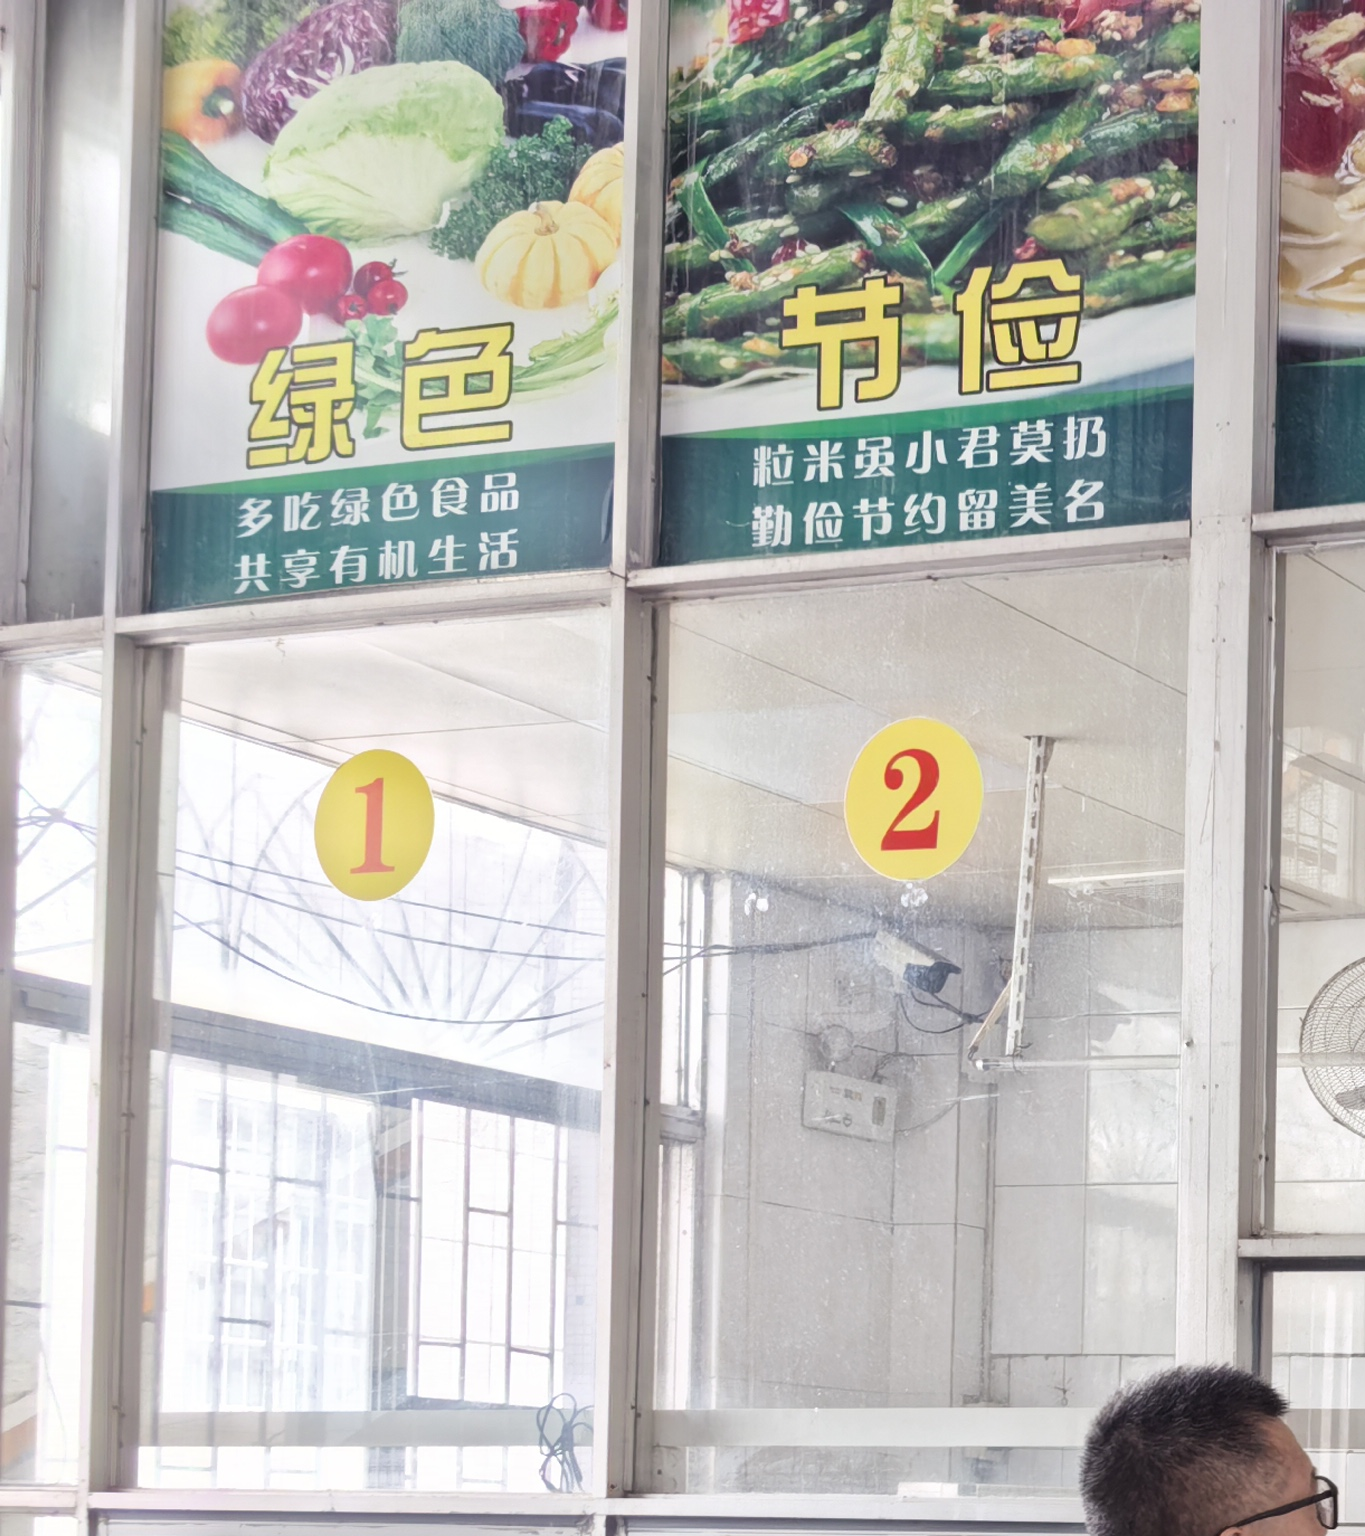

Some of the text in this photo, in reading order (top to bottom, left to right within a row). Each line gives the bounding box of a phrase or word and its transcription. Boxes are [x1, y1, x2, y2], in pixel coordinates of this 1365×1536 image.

[779, 259, 1084, 411] 节俭
[245, 321, 515, 470] 绿色
[752, 415, 1107, 488] 粒米虽小君莫扔
[236, 472, 519, 540] 多吃绿色食品
[751, 479, 1105, 548] 勤俭节约留美名
[233, 530, 519, 595] 共享有机生活
[349, 777, 396, 875] 1
[881, 749, 939, 851] 2
